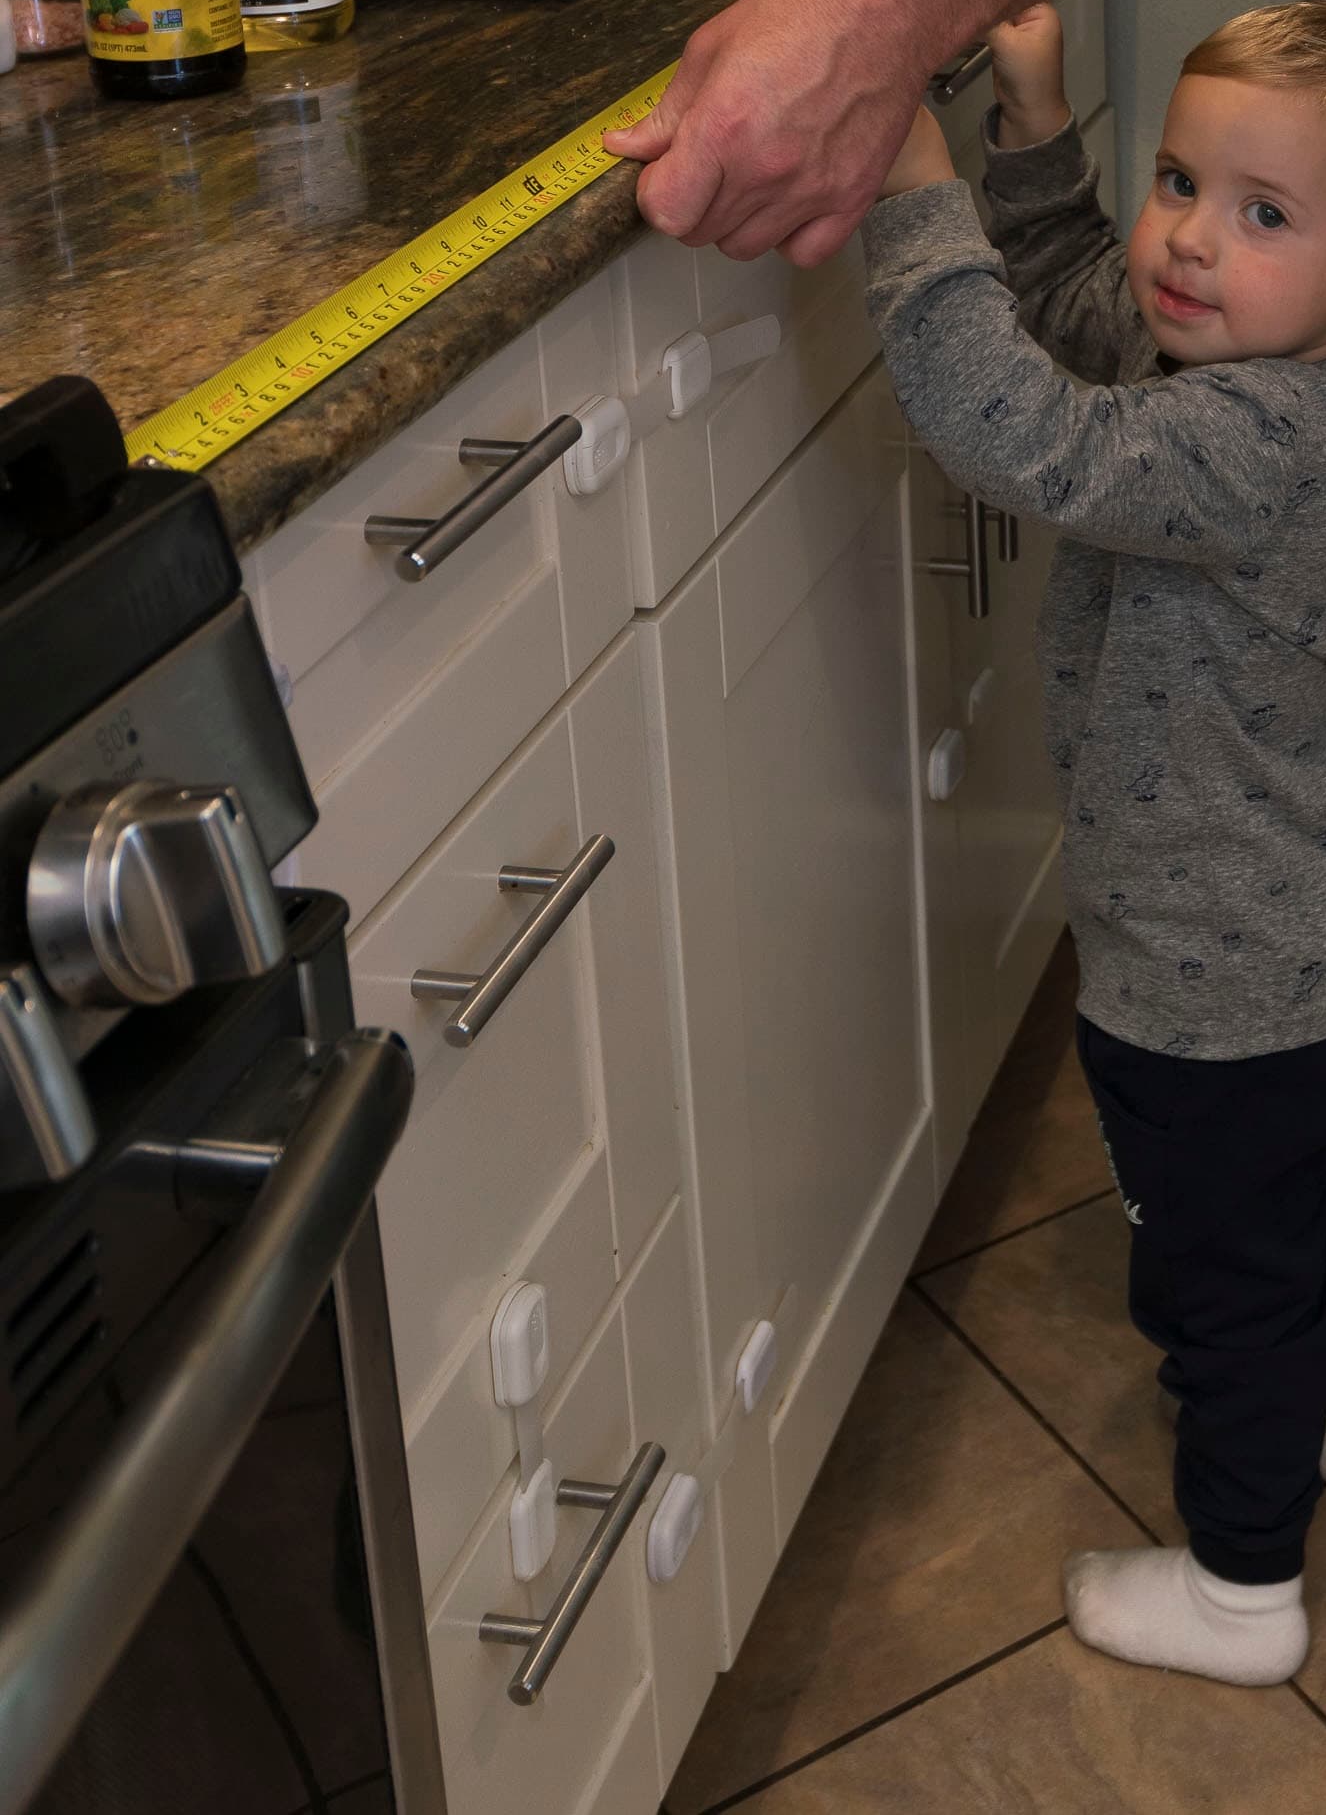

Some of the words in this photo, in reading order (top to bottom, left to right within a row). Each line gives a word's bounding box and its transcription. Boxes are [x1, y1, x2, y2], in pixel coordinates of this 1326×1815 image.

[153, 441, 167, 454] 1
[194, 411, 209, 427] 2
[235, 383, 249, 398] 3
[275, 356, 286, 369] 4
[310, 331, 324, 345] 5
[345, 306, 359, 320] 6
[377, 283, 390, 297] 7
[409, 261, 422, 275] 8
[440, 240, 452, 253] 9
[472, 215, 488, 230] 10
[500, 197, 514, 212] 11
[552, 160, 567, 174] 13
[577, 143, 590, 157] 14
[644, 96, 656, 108] 17
[197, 439, 214, 448] 4
[213, 427, 229, 436] 5
[228, 416, 245, 424] 6
[243, 404, 259, 413] 7
[259, 393, 276, 402] 8
[274, 383, 290, 392] 9
[291, 366, 315, 379] 10
[318, 352, 334, 360] 2
[332, 342, 348, 350] 3
[347, 332, 362, 340] 4
[360, 322, 375, 331] 5
[373, 313, 388, 321] 6
[398, 294, 413, 303] 8
[410, 286, 425, 294] 9
[422, 273, 446, 286] 20
[447, 260, 461, 268] 2
[471, 243, 484, 251] 4
[481, 235, 496, 243] 5
[492, 227, 507, 235] 6
[513, 212, 527, 220] 8
[533, 193, 553, 205] 30
[554, 183, 568, 191] 2
